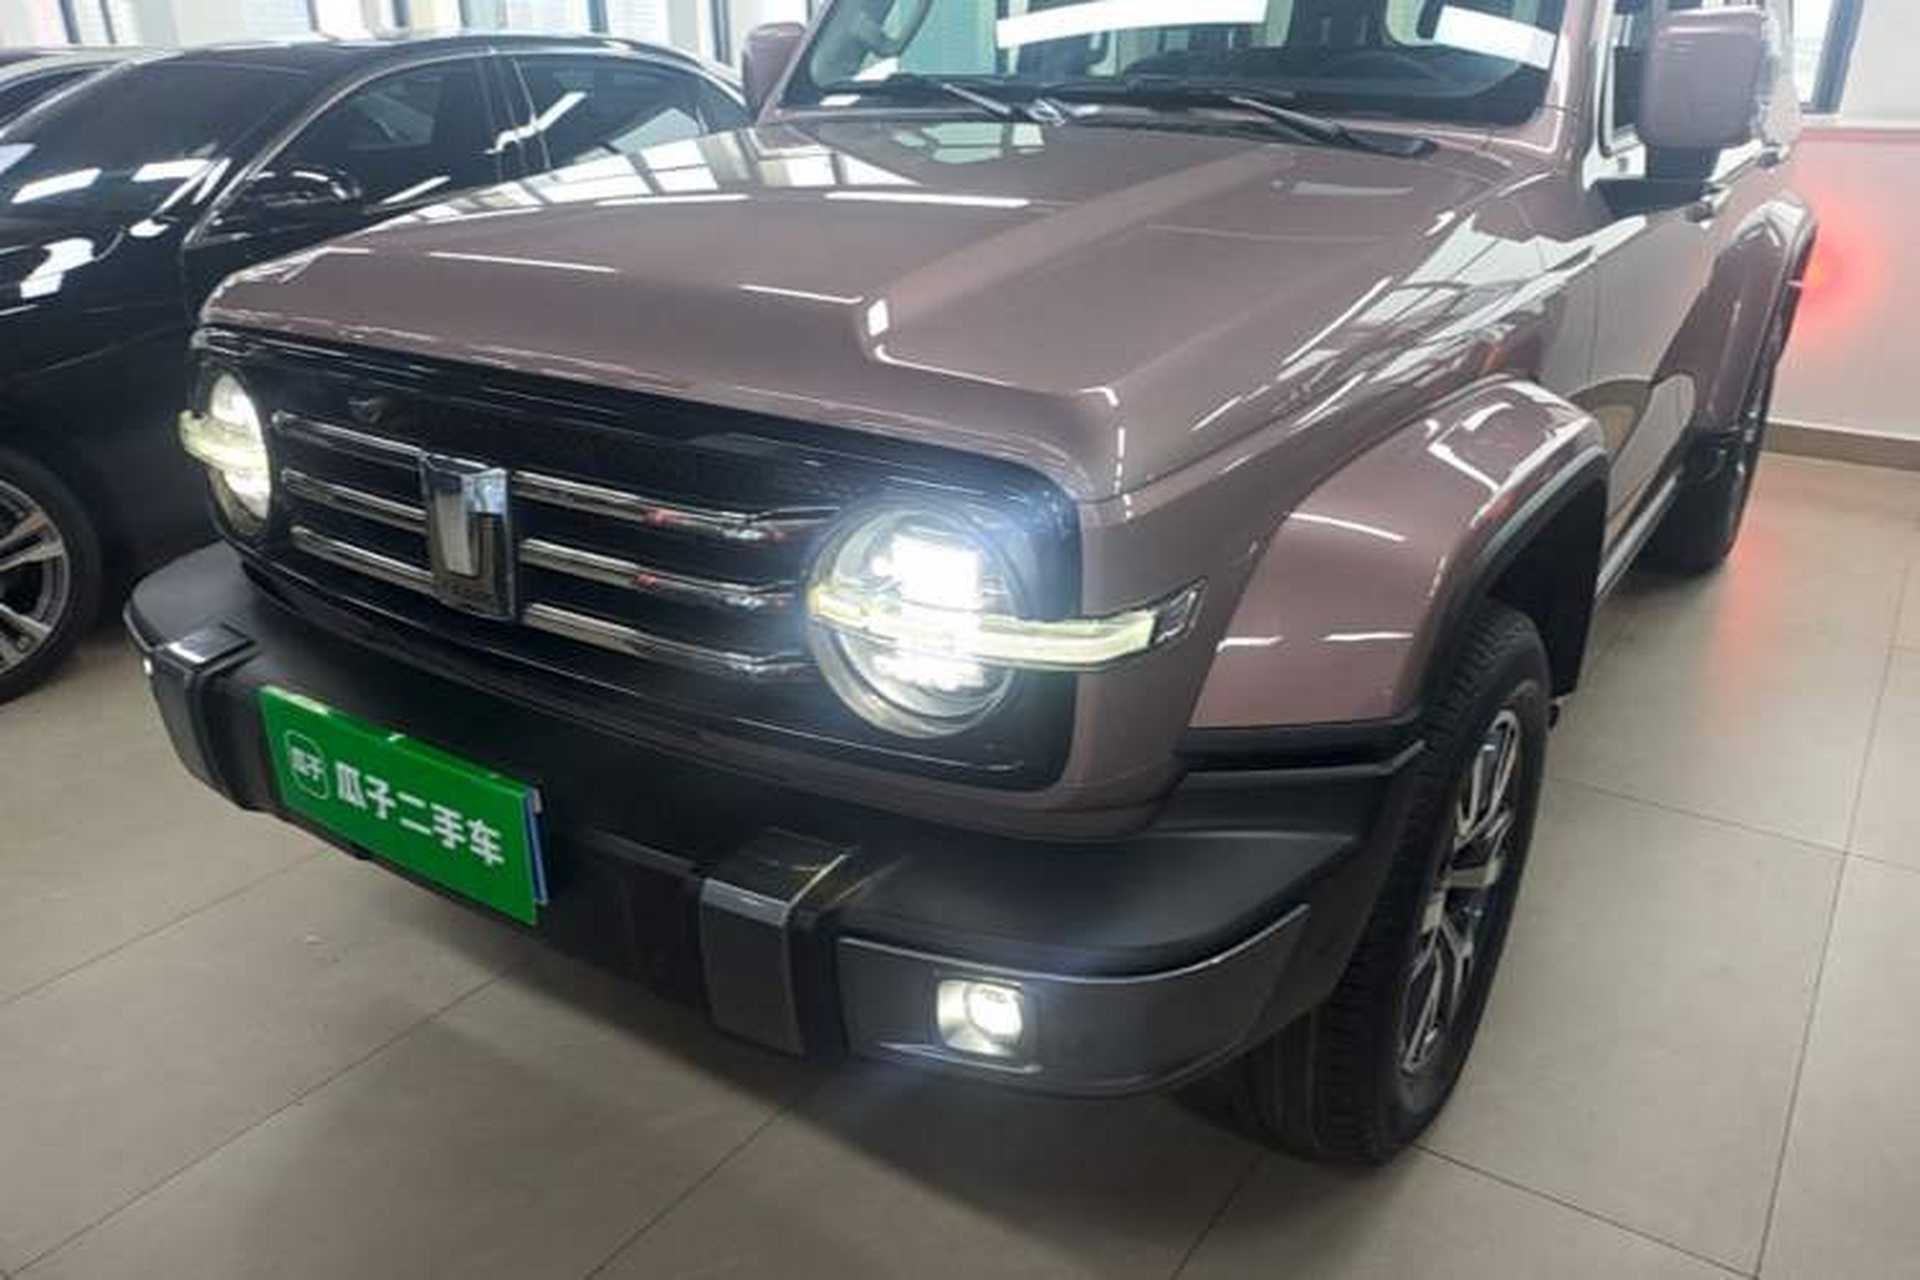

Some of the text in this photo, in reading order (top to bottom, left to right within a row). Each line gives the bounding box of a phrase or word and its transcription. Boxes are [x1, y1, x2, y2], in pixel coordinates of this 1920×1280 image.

[335, 761, 506, 867] 瓜子二手车
